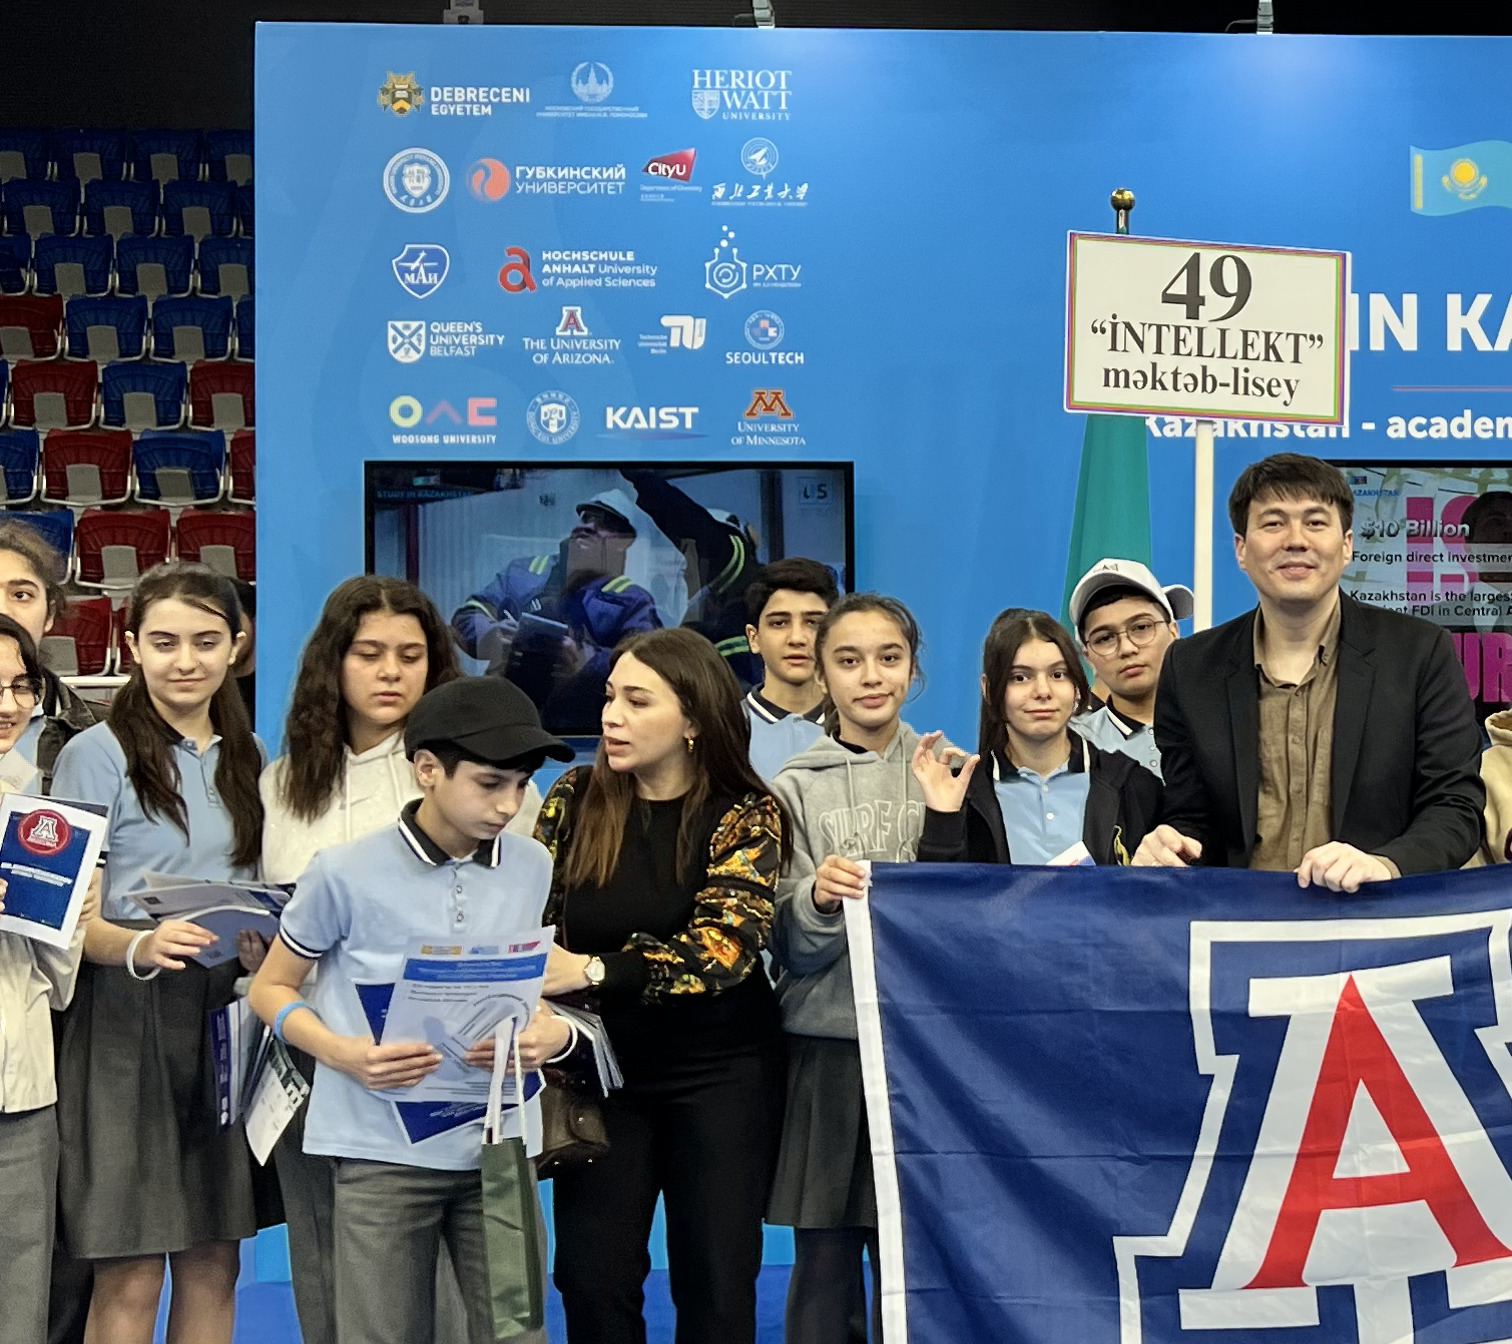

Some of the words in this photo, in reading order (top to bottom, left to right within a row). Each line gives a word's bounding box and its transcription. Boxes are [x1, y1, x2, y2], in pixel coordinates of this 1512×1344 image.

[692, 69, 793, 90] HERIOT
[430, 87, 531, 104] DEBRECENI
[722, 90, 793, 110] WATT
[431, 104, 493, 116] EGYETEM
[722, 112, 791, 121] UNIVERSITY
[515, 163, 627, 180] ГУБКИНСКИЙ
[648, 162, 687, 178] CityU
[515, 181, 626, 195] УНИВЕРСИТЕТ
[542, 250, 635, 262] HOCHSCHULE
[404, 265, 439, 284] МАИ
[542, 264, 596, 274] ANHALT
[598, 264, 658, 276] University
[752, 264, 802, 281] РХТУ
[542, 277, 554, 287] of
[556, 277, 602, 289] Applied
[604, 277, 656, 287] Sciences
[1161, 252, 1252, 322] 49
[430, 321, 483, 333] QUEEN'S
[1350, 293, 1418, 351] IN
[430, 334, 505, 345] UNIVERSITY
[523, 338, 547, 350] THE
[550, 338, 621, 350] UNIVERSITY
[430, 346, 477, 356] BELFAST
[532, 352, 550, 364] OF
[552, 352, 612, 364] ARIZONA
[725, 352, 805, 364] SEOULTECH
[1102, 361, 1300, 406] məktəb-lisey
[744, 390, 794, 419] M
[606, 406, 699, 429] KAIST
[738, 421, 800, 433] UNIVERSITY
[1362, 422, 1376, 430] -
[392, 434, 440, 444] WOOSONG
[443, 434, 497, 444] UNIVERSITY
[731, 435, 743, 446] OF
[745, 435, 806, 446] MINNESOTA
[1406, 519, 1470, 538] Billion
[1352, 551, 1402, 564] Foreign
[1406, 551, 1444, 563] direct
[1350, 590, 1427, 601] Kazakhstan
[1431, 590, 1441, 601] is
[1445, 590, 1466, 601] the
[1412, 605, 1434, 616] FDI
[1438, 605, 1450, 616] in
[1454, 605, 1503, 616] Central
